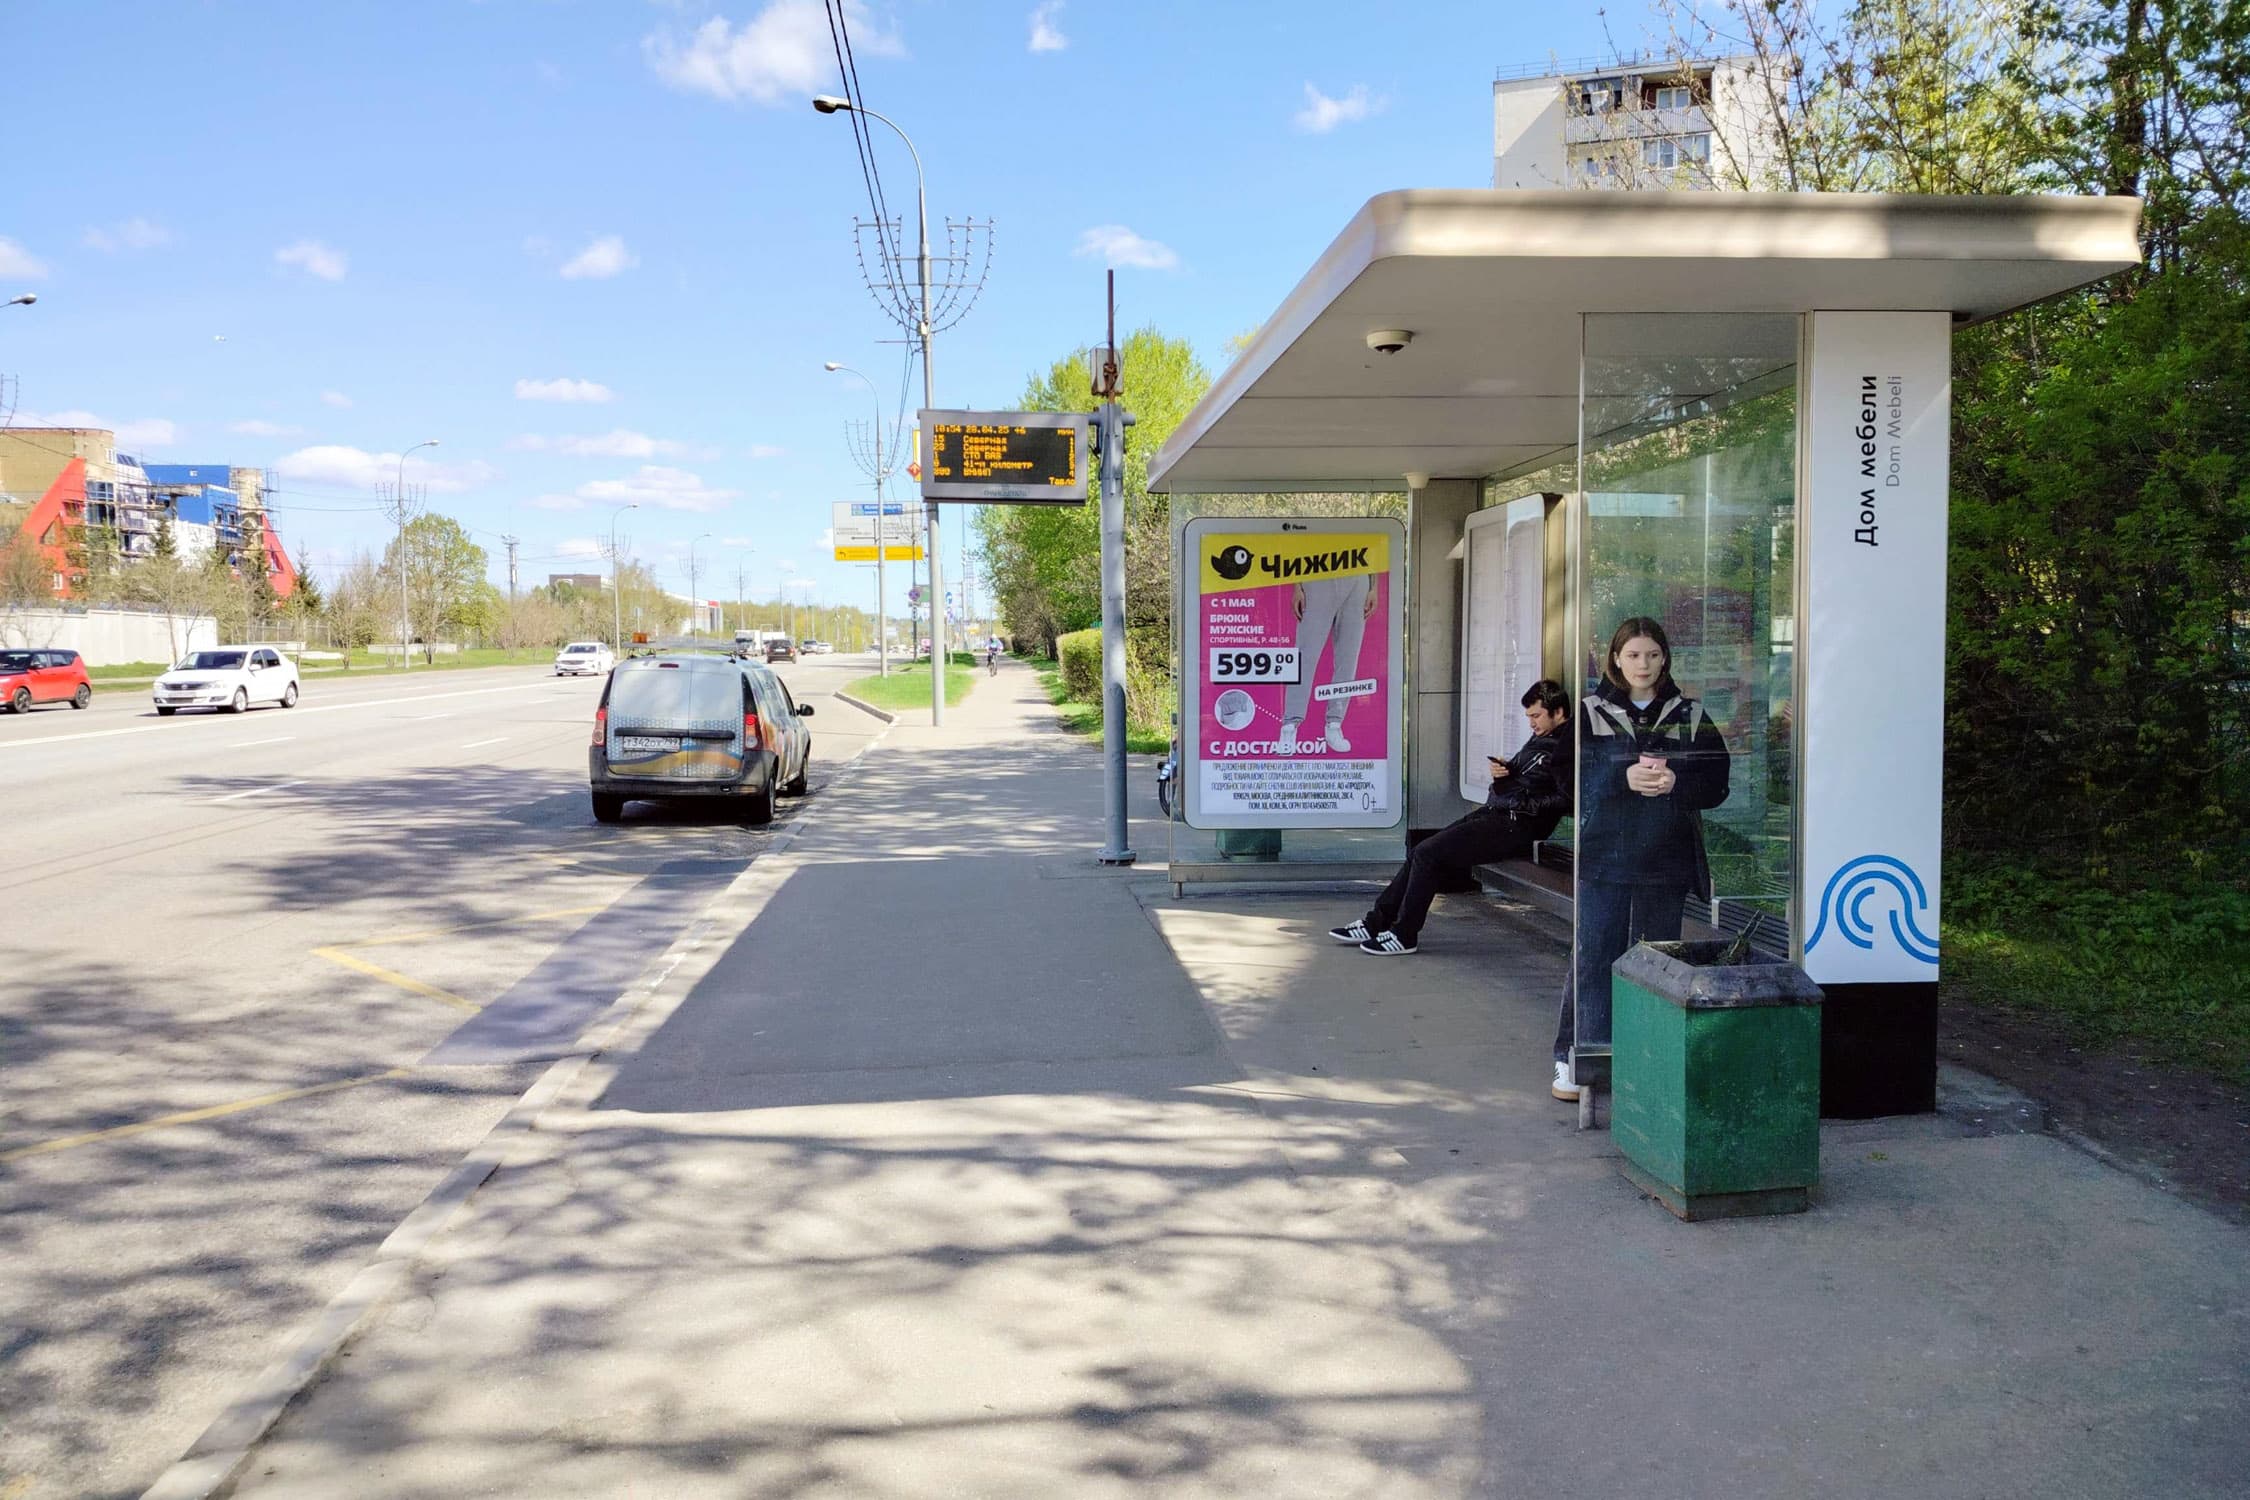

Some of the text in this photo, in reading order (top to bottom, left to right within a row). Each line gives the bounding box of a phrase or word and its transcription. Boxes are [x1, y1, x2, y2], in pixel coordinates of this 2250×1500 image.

[1886, 376, 1902, 487] Dom Mebeli
[963, 452, 980, 460] СТО
[1855, 376, 1878, 546] Дом мебели
[1210, 598, 1255, 608] С 1 МАЯ
[1209, 614, 1249, 624] БРЮКИ
[1209, 625, 1265, 635] МУЖСКИЕ
[1209, 636, 1260, 645] СПОРТИВНЫЕ,
[1217, 652, 1295, 677] 599 00
[1318, 682, 1374, 698] НА РЕЗИНКЕ
[1209, 737, 1328, 758] С ДОСТАВКОЙ
[1362, 792, 1377, 811] 0+
